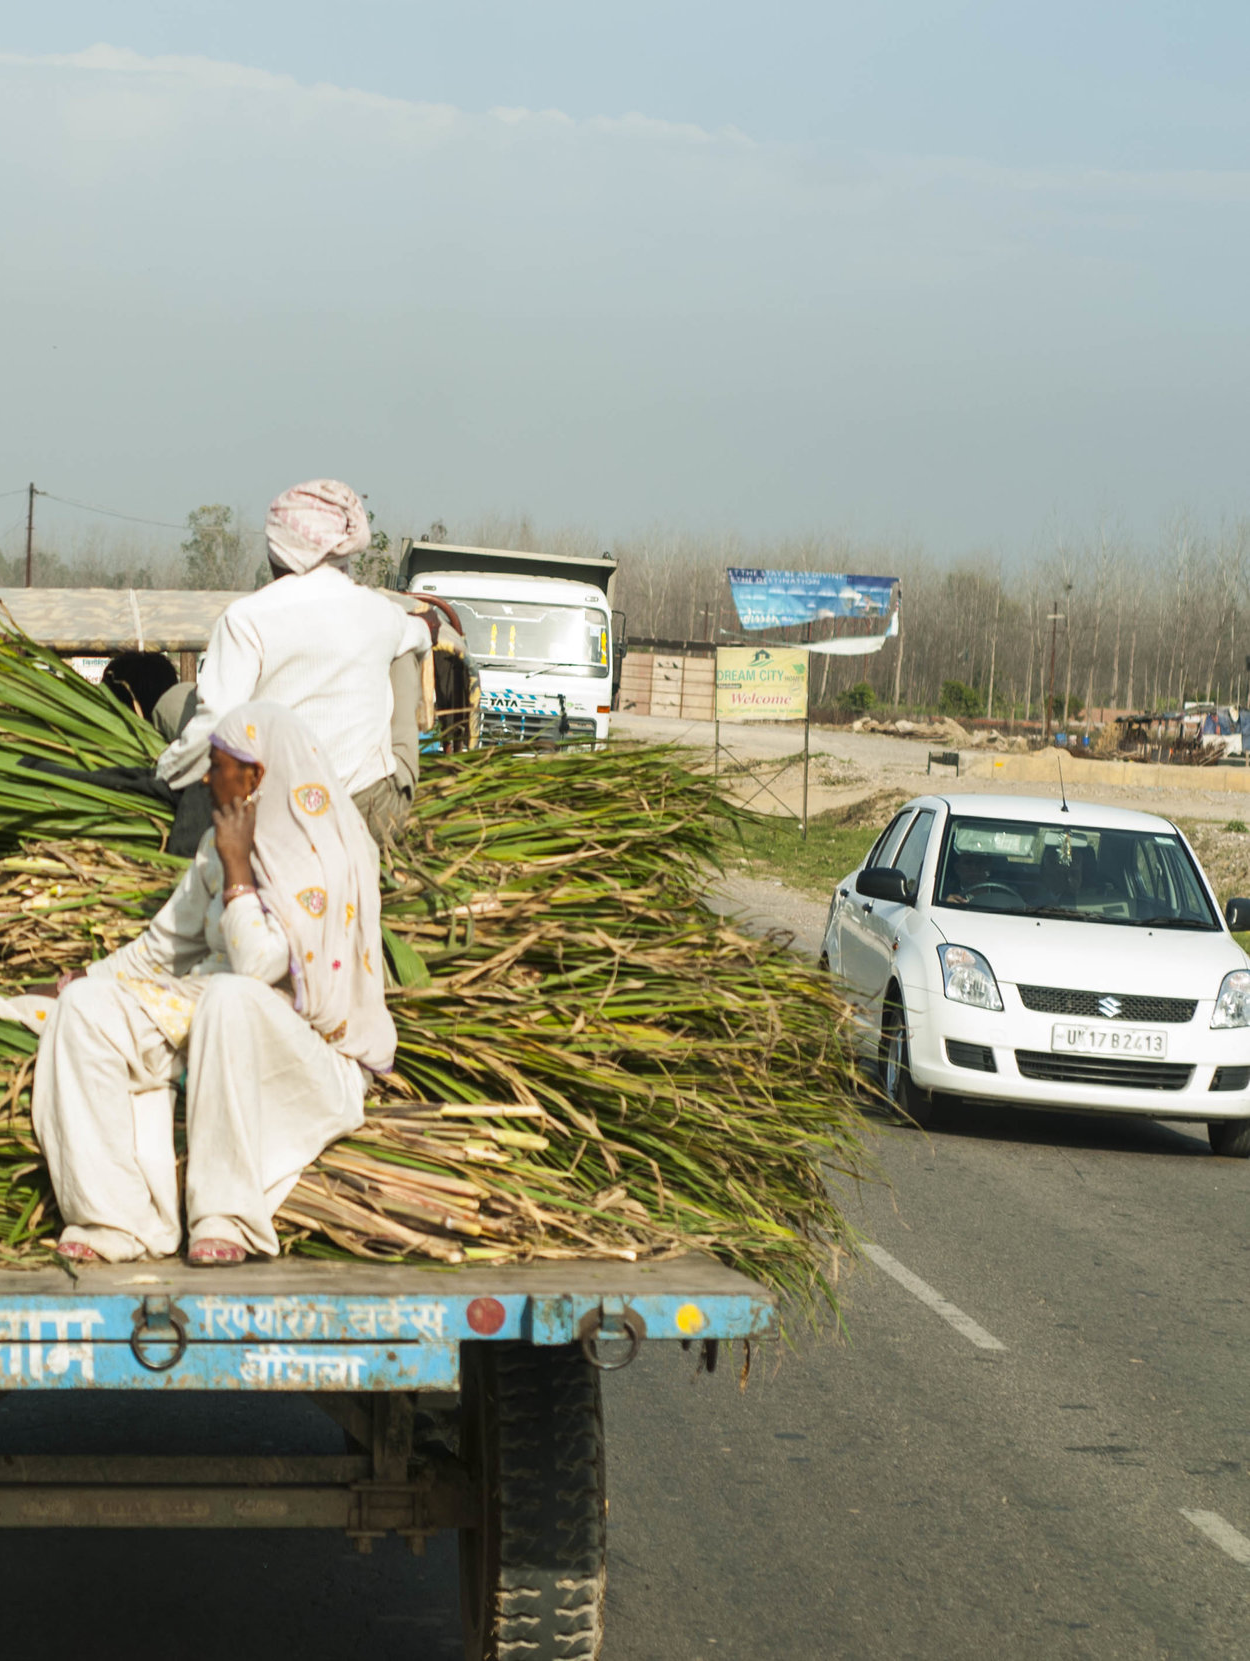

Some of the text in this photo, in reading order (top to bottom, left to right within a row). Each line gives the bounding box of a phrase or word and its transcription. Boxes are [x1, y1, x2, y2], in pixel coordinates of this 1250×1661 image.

[755, 577, 820, 585] DESTINATION
[812, 571, 844, 581] DIVINE
[717, 669, 756, 681] DREAM
[759, 669, 784, 681] CITY
[490, 698, 518, 707] TATA
[731, 692, 792, 705] Welcome
